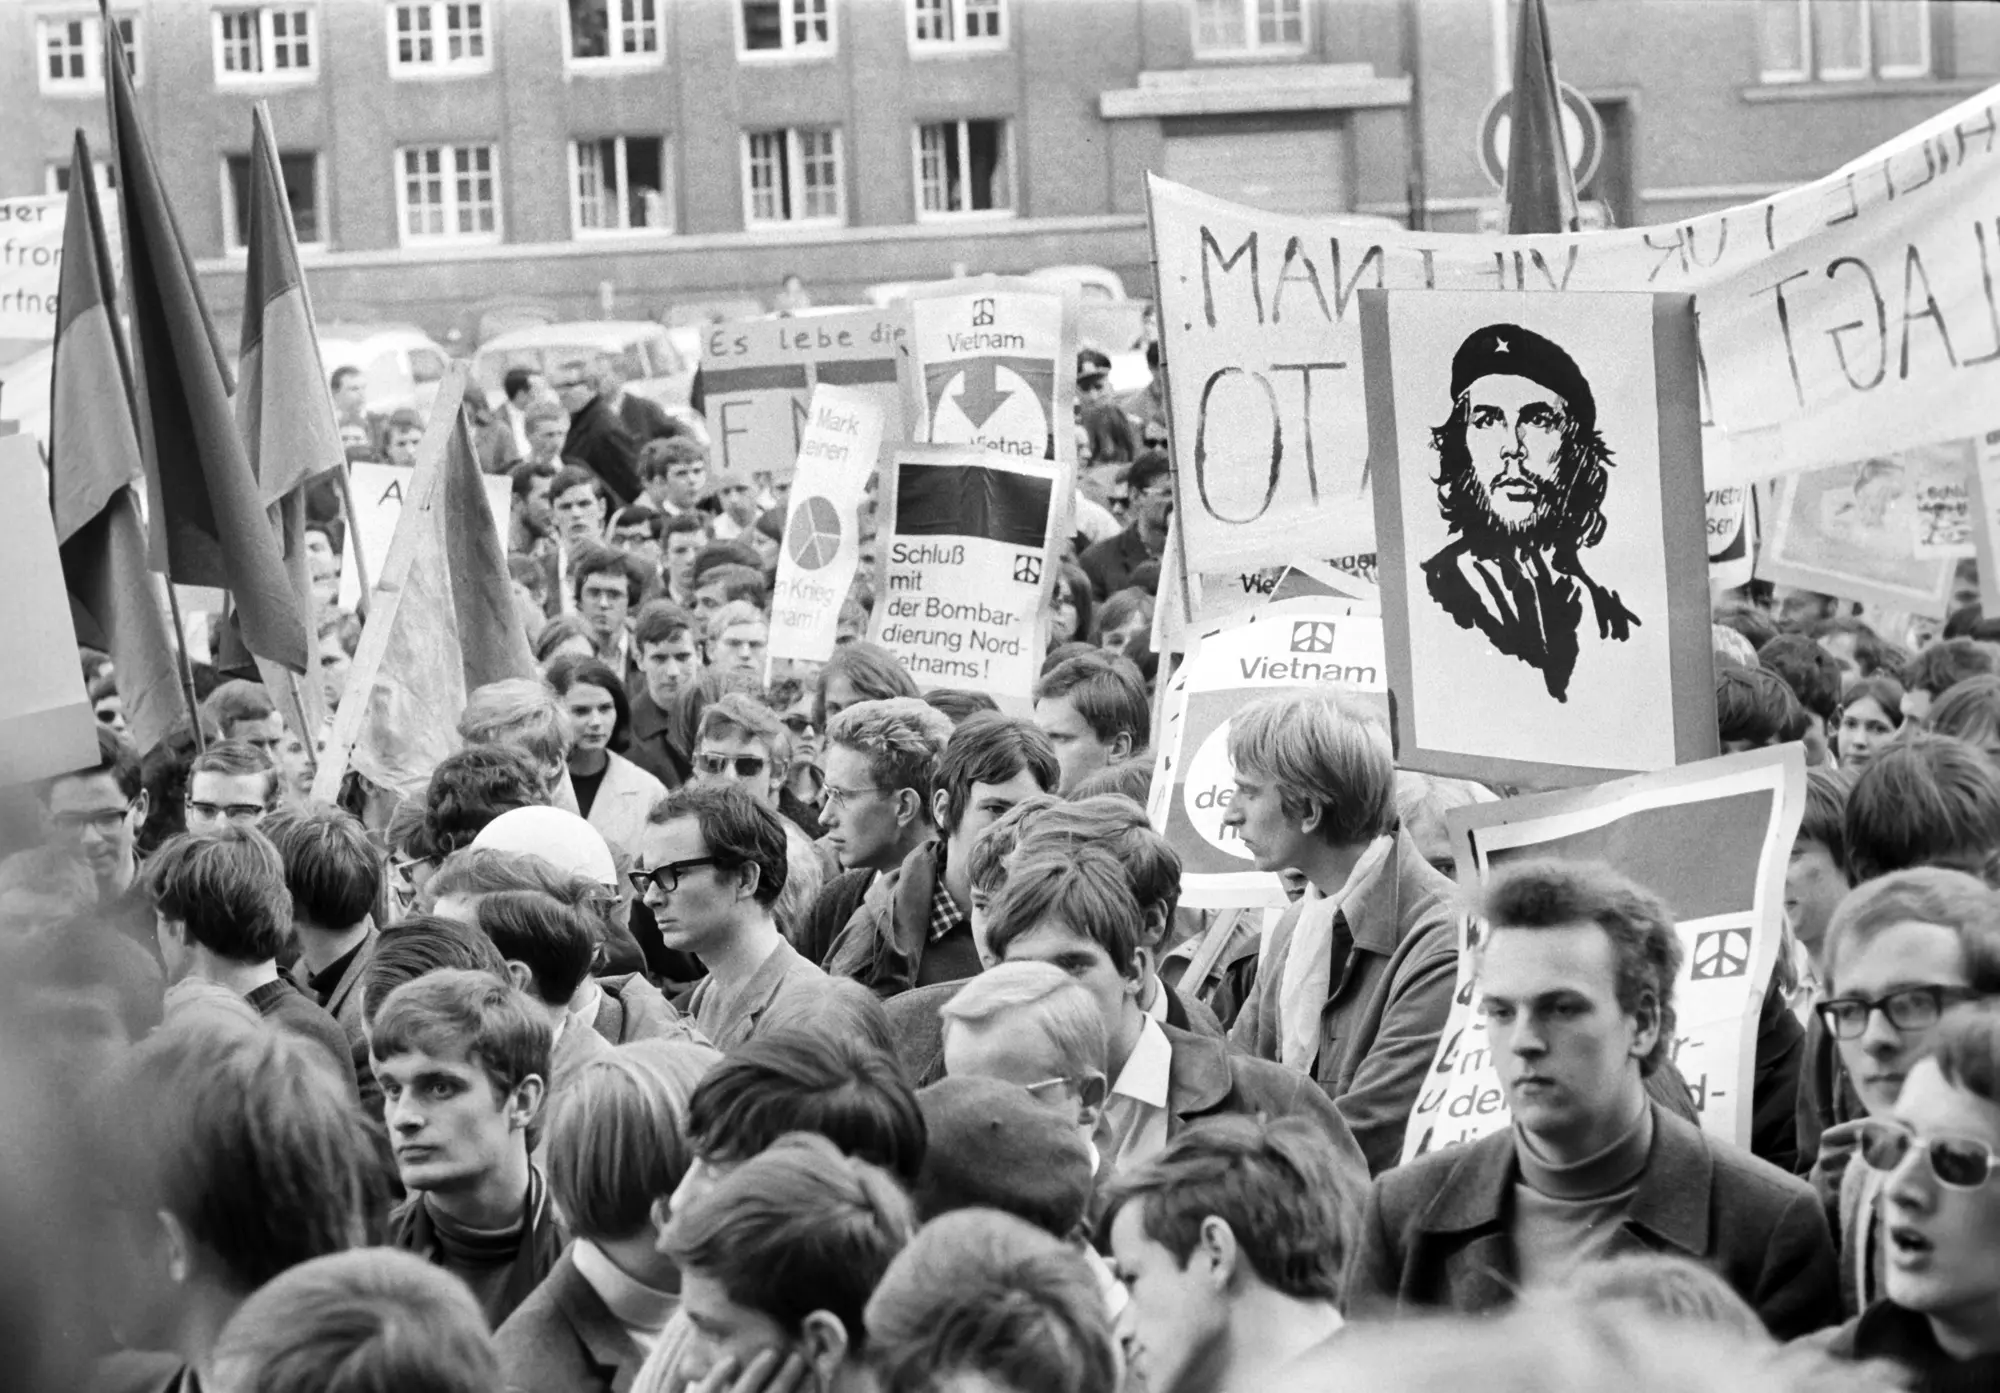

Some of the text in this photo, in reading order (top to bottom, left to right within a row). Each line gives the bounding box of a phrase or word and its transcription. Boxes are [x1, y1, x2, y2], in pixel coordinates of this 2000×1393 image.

[708, 321, 906, 357] Es lebe die
[948, 332, 1025, 352] Vietnam
[891, 542, 965, 565] Schluß
[890, 570, 923, 591] mit
[888, 596, 1020, 626] der Bombar-
[882, 624, 1028, 656] dierung Nord-
[1240, 657, 1378, 685] Vietnam
